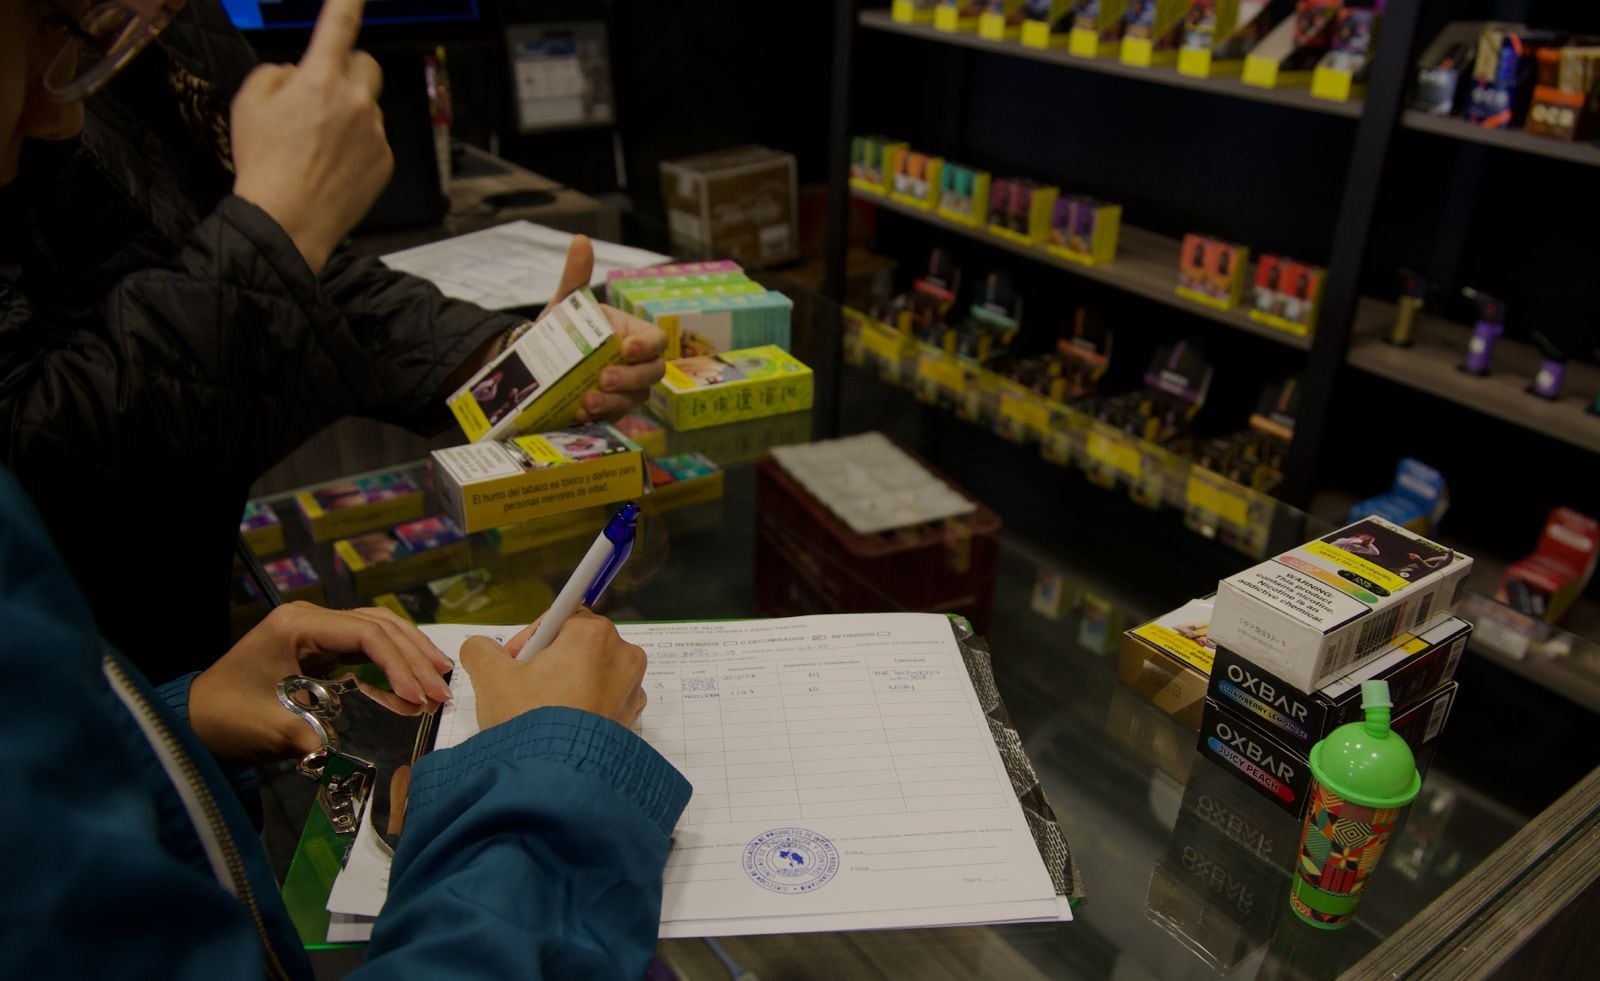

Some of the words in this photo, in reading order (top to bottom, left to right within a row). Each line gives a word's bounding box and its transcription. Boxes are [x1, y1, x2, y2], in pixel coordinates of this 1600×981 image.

[472, 494, 481, 504] El
[483, 488, 506, 502] humo
[508, 486, 521, 500] del
[522, 484, 549, 497] tabaco
[550, 480, 560, 490] es
[618, 465, 637, 478] para
[503, 498, 540, 512] personas
[542, 490, 576, 504] menores
[577, 485, 586, 497] de
[587, 482, 608, 494] edad
[1238, 579, 1279, 600] addictive
[1280, 600, 1323, 624] chemical.
[1256, 574, 1294, 593] contains
[1296, 592, 1334, 615] nicotine.
[1258, 580, 1296, 600] Nicotine
[1306, 605, 1319, 614] an
[1276, 574, 1294, 586] This
[1295, 584, 1332, 605] product
[1286, 573, 1334, 598] WARNING:
[1220, 684, 1267, 714] STRAWBERRY
[1228, 664, 1308, 722] OXBAR
[1216, 723, 1294, 784] OXBAR
[1218, 744, 1244, 767] JUICY
[1246, 764, 1280, 792] PEACH
